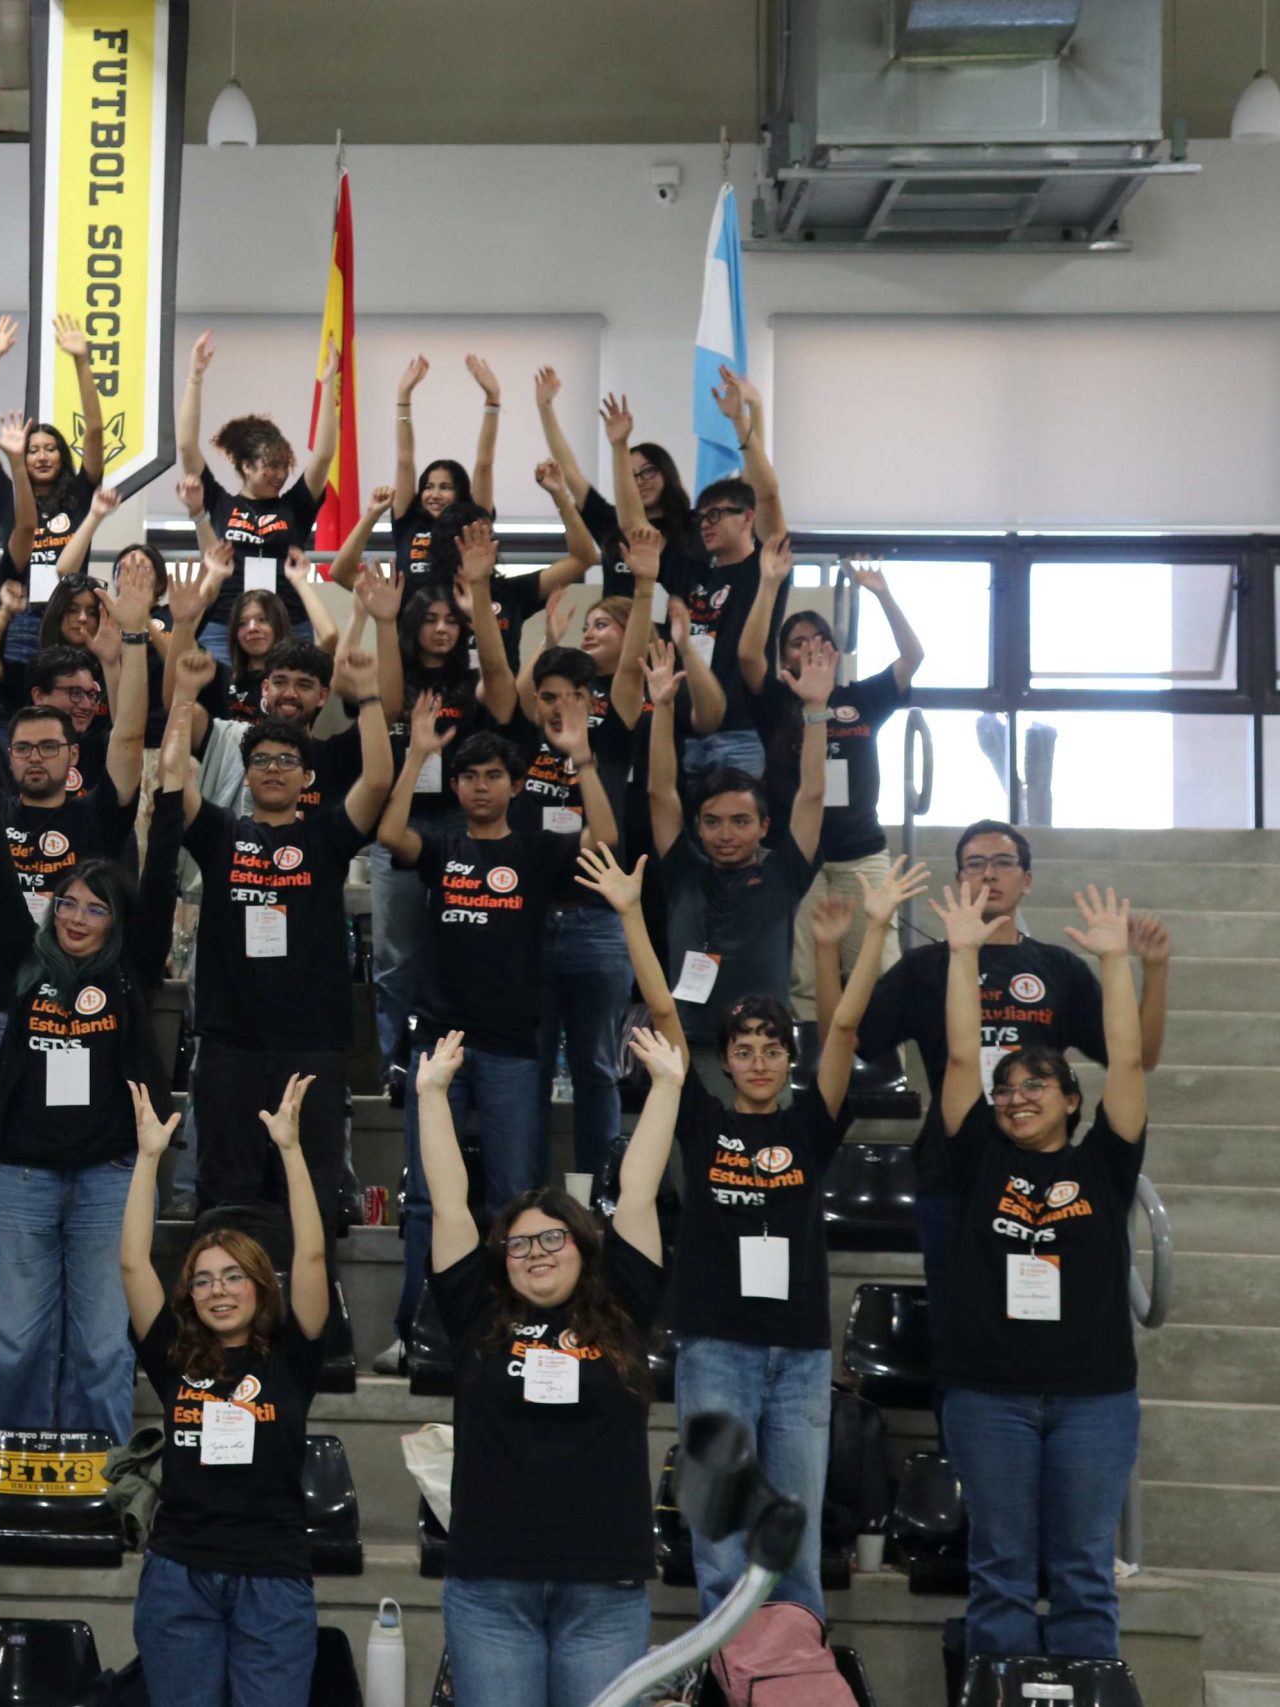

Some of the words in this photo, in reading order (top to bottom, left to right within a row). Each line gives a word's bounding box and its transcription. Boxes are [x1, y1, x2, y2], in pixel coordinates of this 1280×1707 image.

[88, 29, 128, 206] FUTBOL
[85, 225, 123, 397] SOCCER
[4, 827, 29, 843] Soy
[9, 842, 36, 859] íder
[235, 841, 263, 855] Soy
[232, 853, 272, 871] Líder
[445, 859, 475, 876] Soy
[18, 872, 45, 887] TYS
[229, 870, 313, 888] Estudiantil
[441, 874, 482, 891] Líder
[229, 887, 279, 905] CETYS
[443, 892, 525, 911] Estudiantil
[441, 908, 489, 925] CETYS
[38, 983, 57, 997] So
[979, 1004, 1055, 1025] tudiantil
[716, 1134, 746, 1152] Soy
[715, 1151, 751, 1169] Líde
[997, 1196, 1094, 1226] Estuiantil
[991, 1216, 1057, 1242] CETYS
[174, 1402, 276, 1425] Esttil
